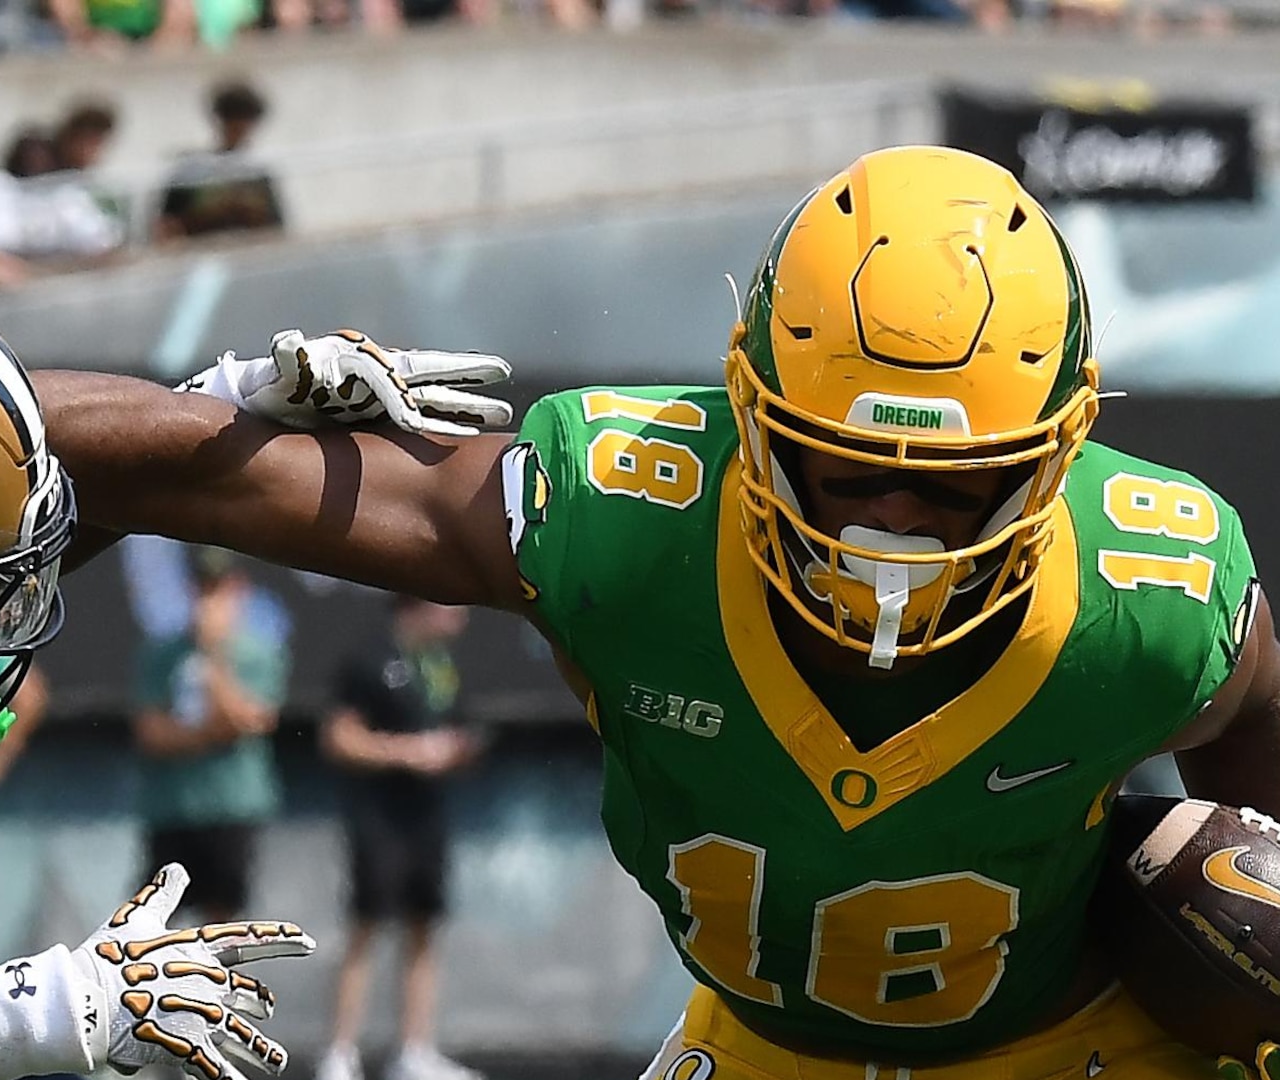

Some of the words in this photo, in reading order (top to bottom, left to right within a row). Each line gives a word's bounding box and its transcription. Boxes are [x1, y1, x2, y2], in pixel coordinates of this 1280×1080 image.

[582, 391, 706, 510] 18
[871, 403, 943, 430] OREGON
[1098, 471, 1220, 603] 18
[666, 832, 1020, 1028] 18
